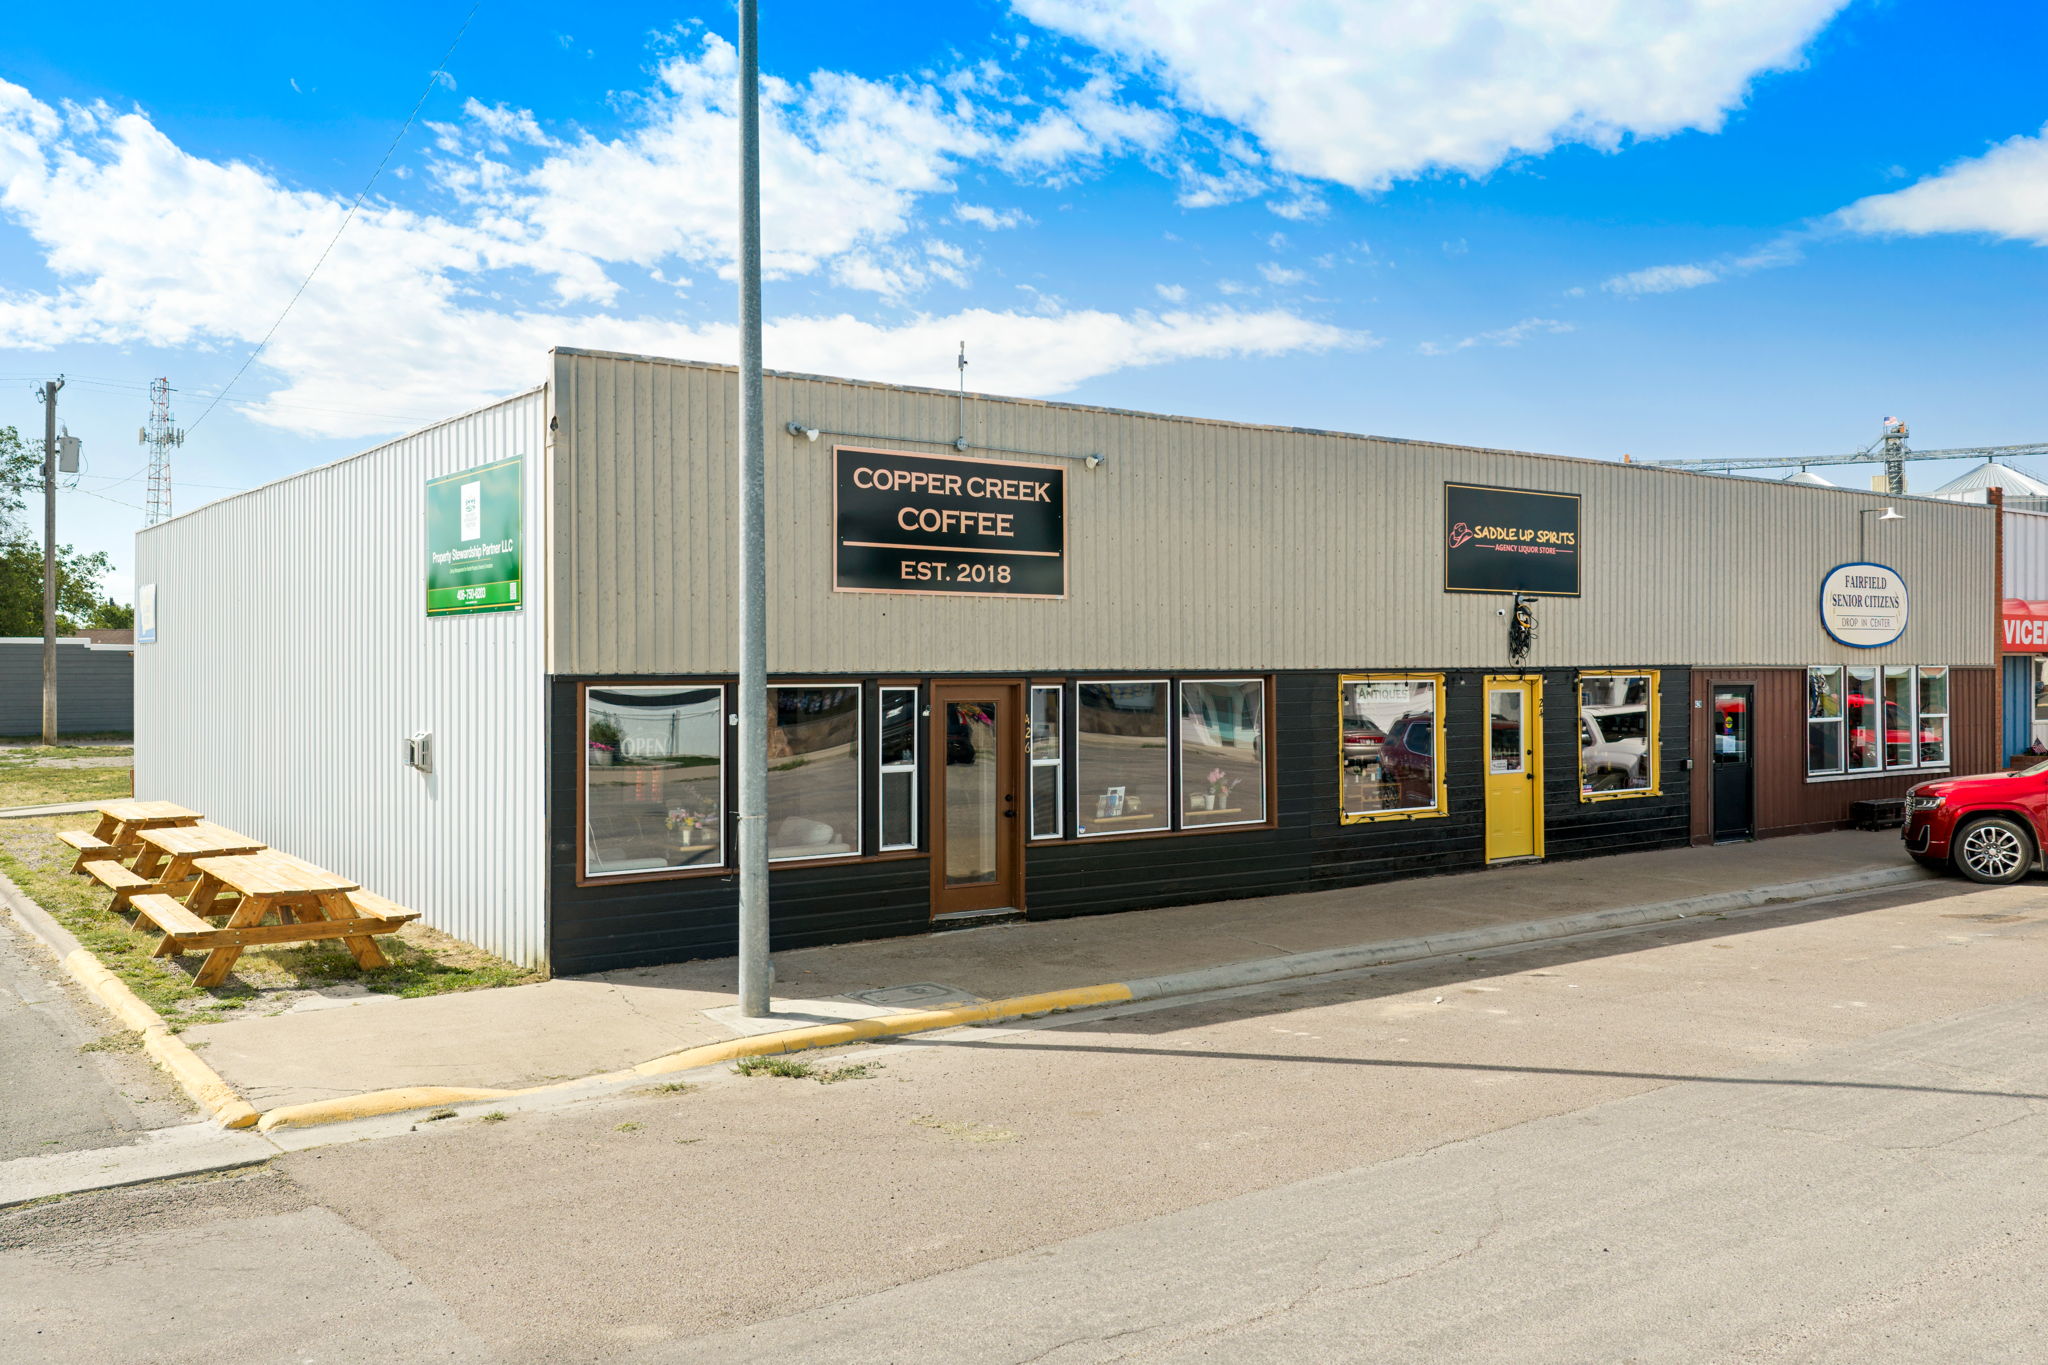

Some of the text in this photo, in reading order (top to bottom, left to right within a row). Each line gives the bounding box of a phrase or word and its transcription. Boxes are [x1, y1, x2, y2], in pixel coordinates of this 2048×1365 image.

[853, 467, 1051, 502] COPPER CREEK
[897, 507, 1014, 537] COFFEE
[1474, 526, 1575, 545] SADDLE UP SPIRITS
[501, 539, 513, 552] LLC
[1495, 544, 1517, 552] AGENCY
[1518, 545, 1538, 554] LIQUOR
[901, 560, 1011, 584] EST. 2018
[1845, 575, 1887, 590] FAIRFIELD
[1832, 593, 1900, 609] SENIOR CITIZENS
[1841, 617, 1891, 628] DROP IN CENTER
[1359, 686, 1409, 700] ANTIQUES
[621, 737, 667, 757] OPEN
